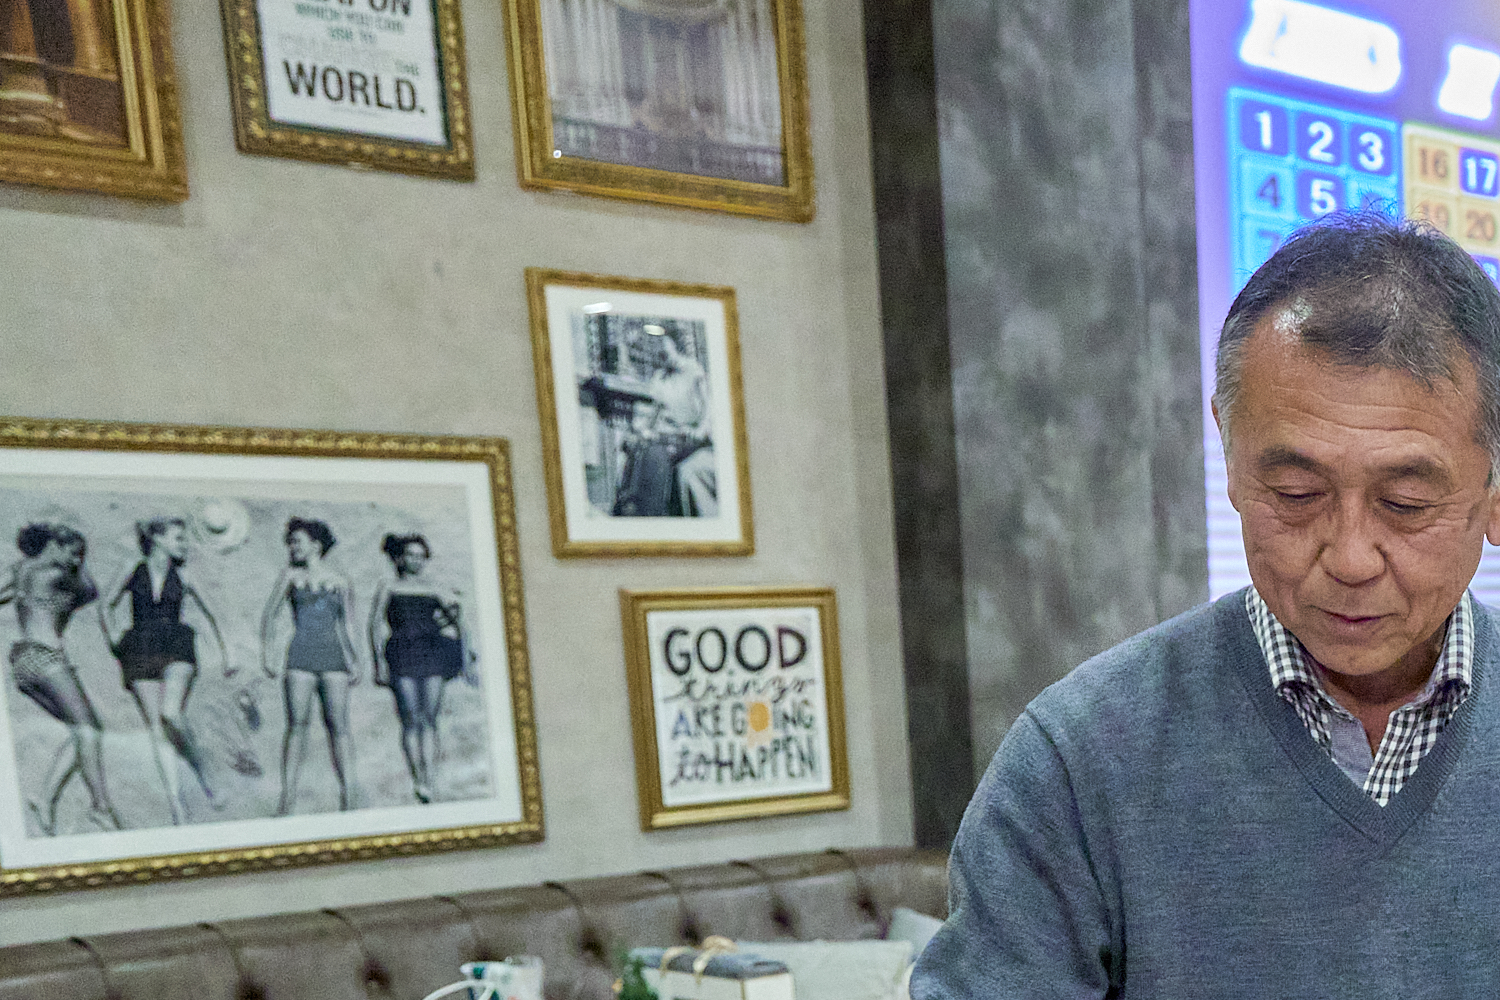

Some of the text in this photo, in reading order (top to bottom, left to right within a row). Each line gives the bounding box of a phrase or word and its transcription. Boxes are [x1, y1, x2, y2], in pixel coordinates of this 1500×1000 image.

[282, 60, 426, 114] WORLD.
[1255, 109, 1384, 171] 1 2 3
[1258, 175, 1281, 209] 4
[1310, 179, 1337, 215] 5
[1464, 155, 1498, 194] 17
[663, 624, 808, 677] GOOD
